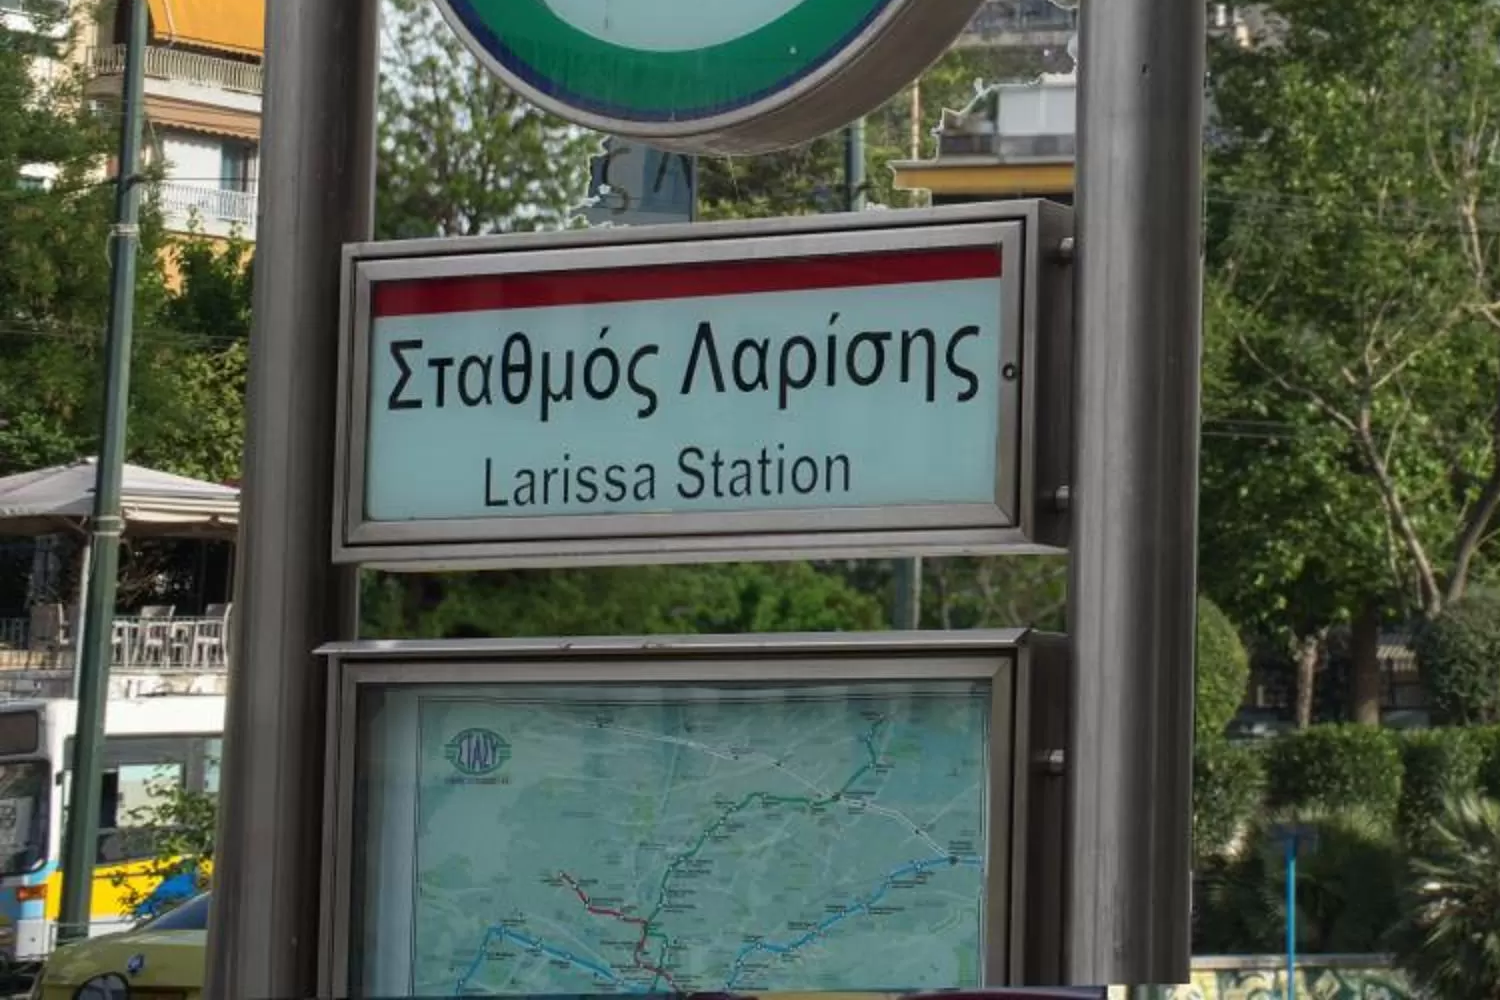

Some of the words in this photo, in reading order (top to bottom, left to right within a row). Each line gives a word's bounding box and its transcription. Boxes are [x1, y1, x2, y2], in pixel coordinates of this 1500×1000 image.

[387, 325, 660, 422] Σταθμός
[679, 312, 981, 411] Λαρίσης
[483, 453, 656, 507] Larissa
[676, 443, 851, 500] Station
